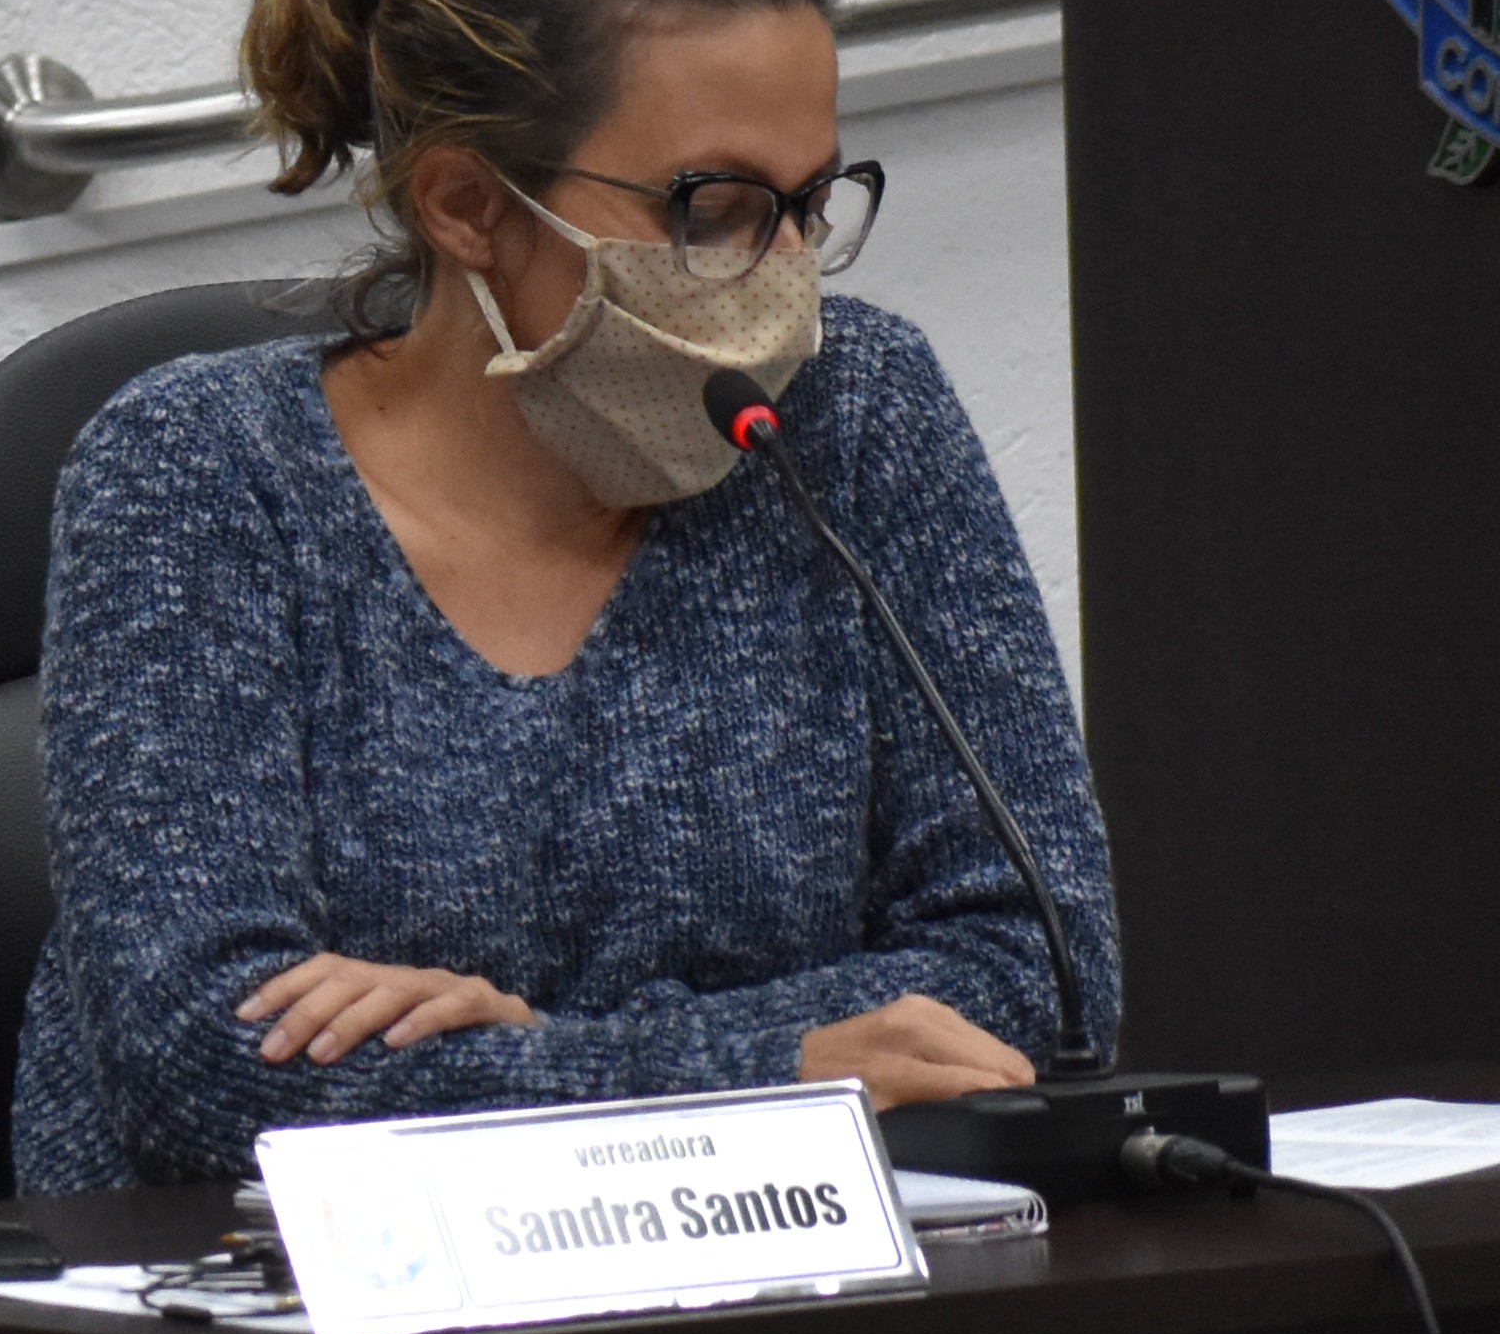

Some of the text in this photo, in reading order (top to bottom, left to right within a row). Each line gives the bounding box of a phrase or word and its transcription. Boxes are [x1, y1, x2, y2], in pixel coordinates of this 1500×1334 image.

[1435, 36, 1500, 125] CO
[574, 1132, 717, 1168] vereadora
[484, 1180, 848, 1256] Sandra Santos
